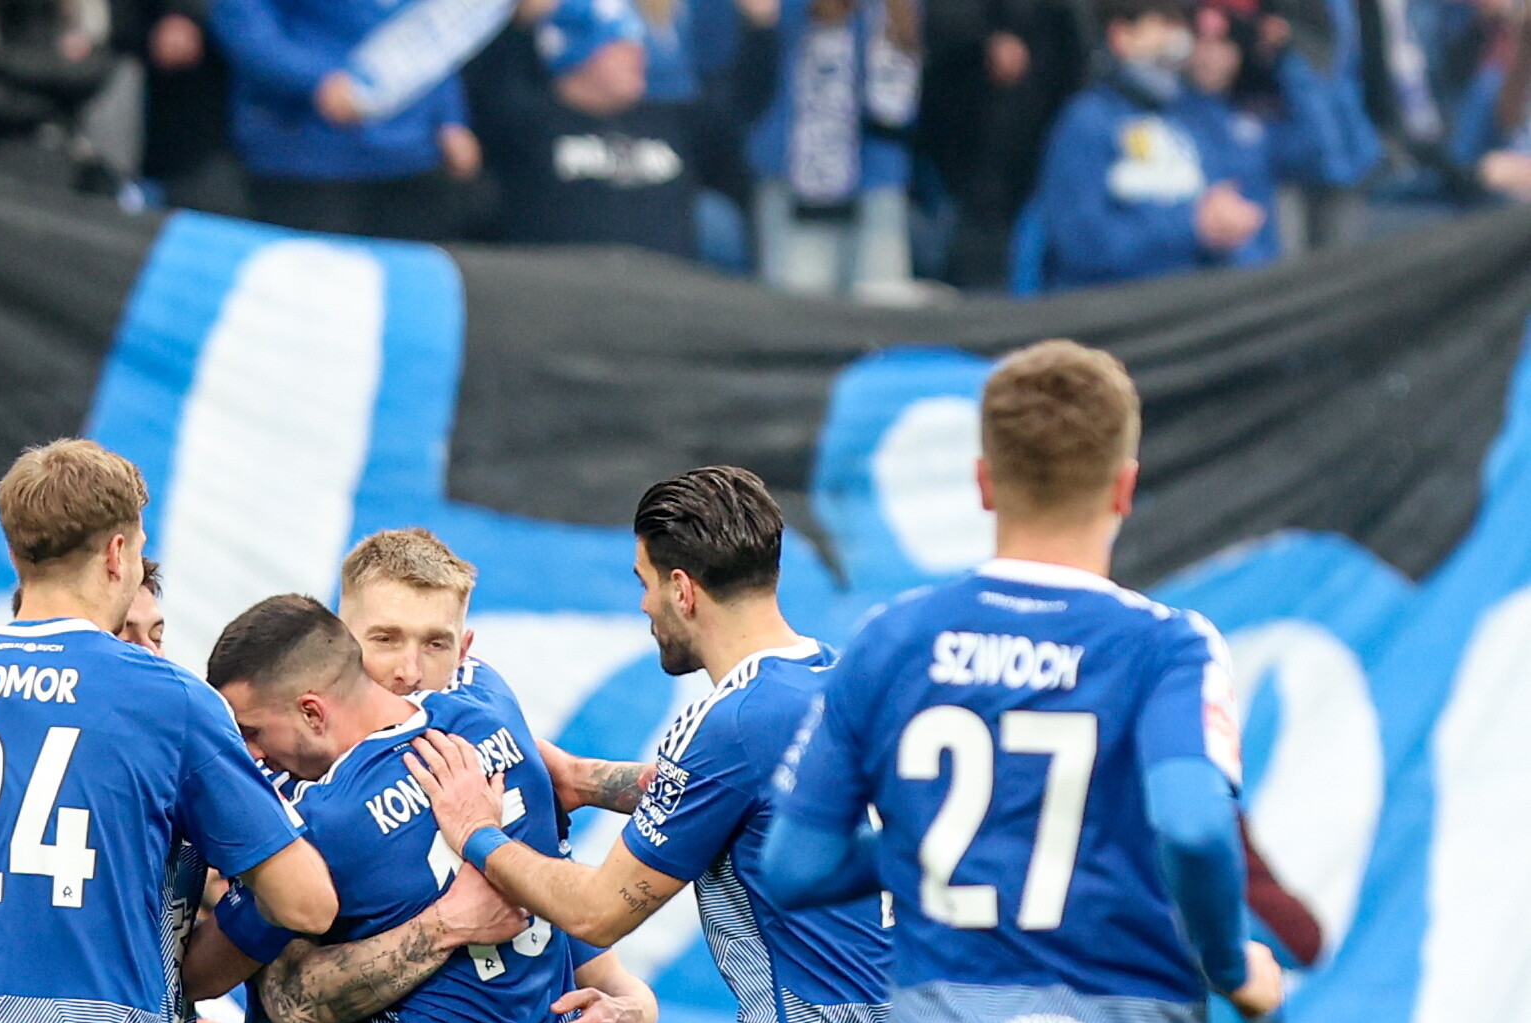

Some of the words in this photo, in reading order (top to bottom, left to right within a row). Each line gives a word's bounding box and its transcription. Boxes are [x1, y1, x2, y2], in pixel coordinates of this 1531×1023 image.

[930, 631, 1084, 690] SZWOCH
[366, 727, 525, 835] KONWSKI
[897, 705, 1097, 931] 27
